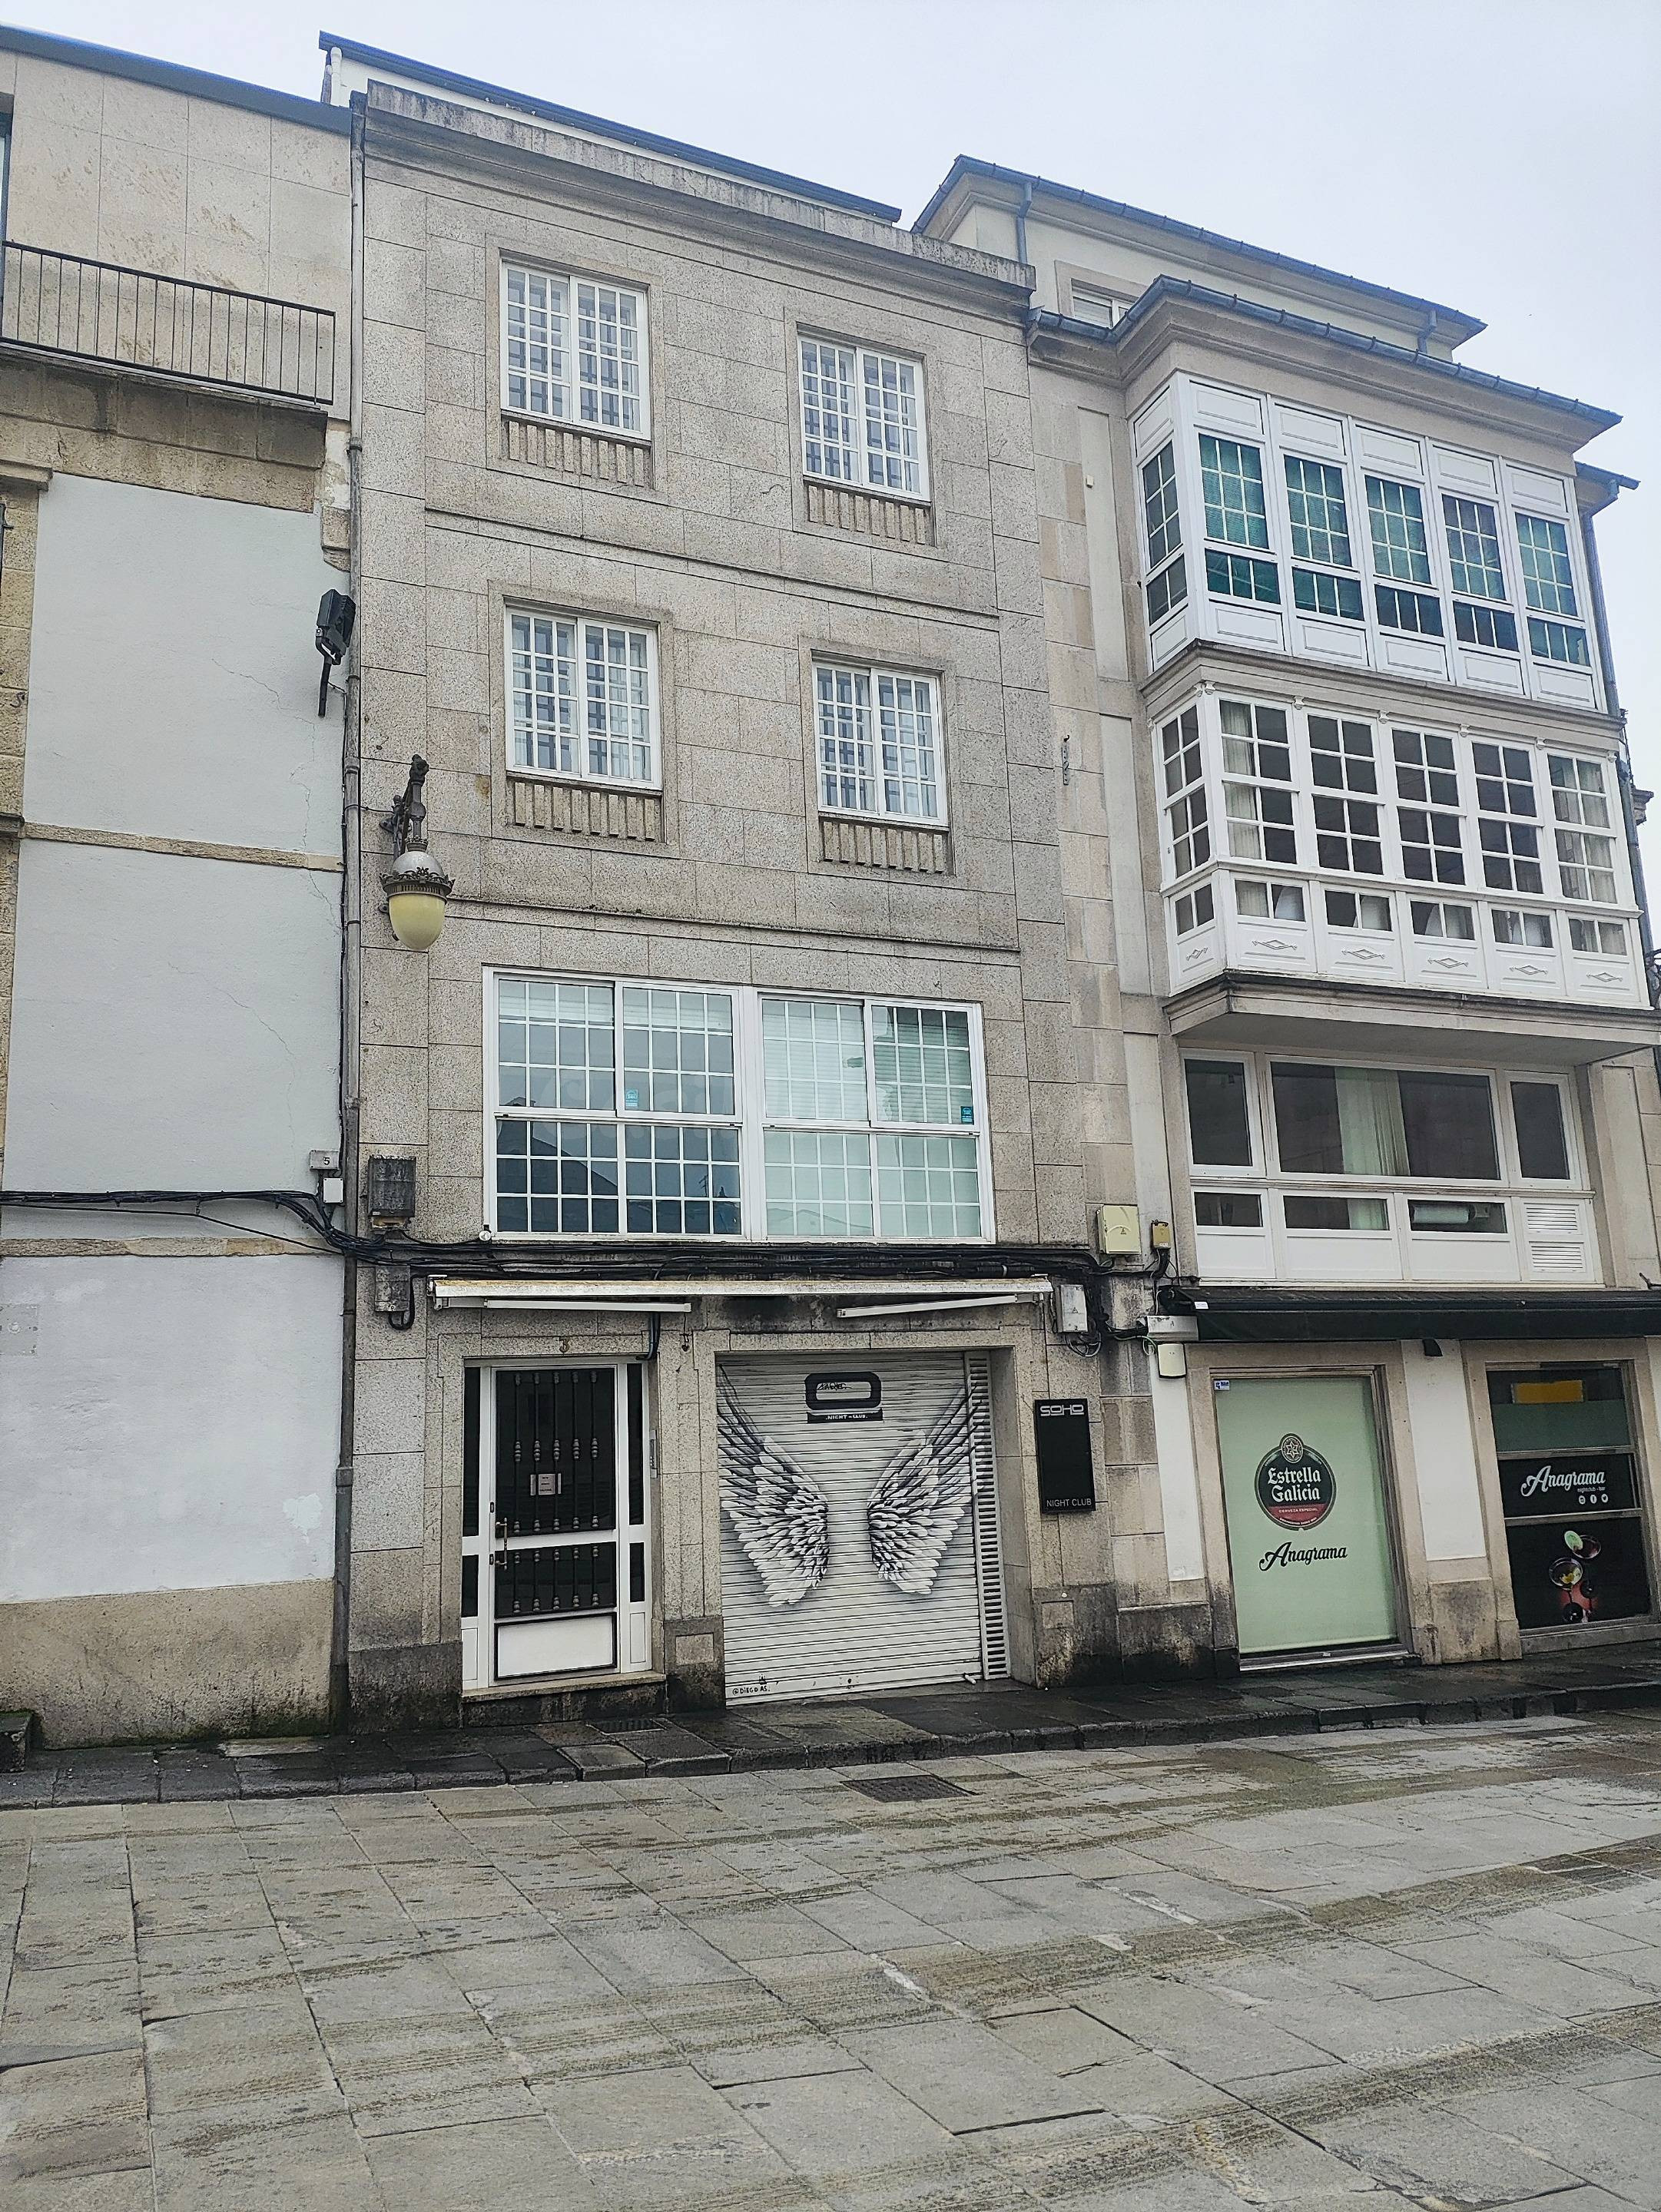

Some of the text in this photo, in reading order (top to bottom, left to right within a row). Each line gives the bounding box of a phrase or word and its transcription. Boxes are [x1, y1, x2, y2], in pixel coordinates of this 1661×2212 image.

[323, 1157, 330, 1165] 5
[1039, 1404, 1085, 1417] SOHO
[1268, 1466, 1321, 1485] Estrella
[1520, 1465, 1606, 1497] Anagrama
[1271, 1483, 1321, 1502] Galicia
[1046, 1498, 1092, 1507] NIGHT CLUB
[1259, 1541, 1348, 1571] Anagrama
